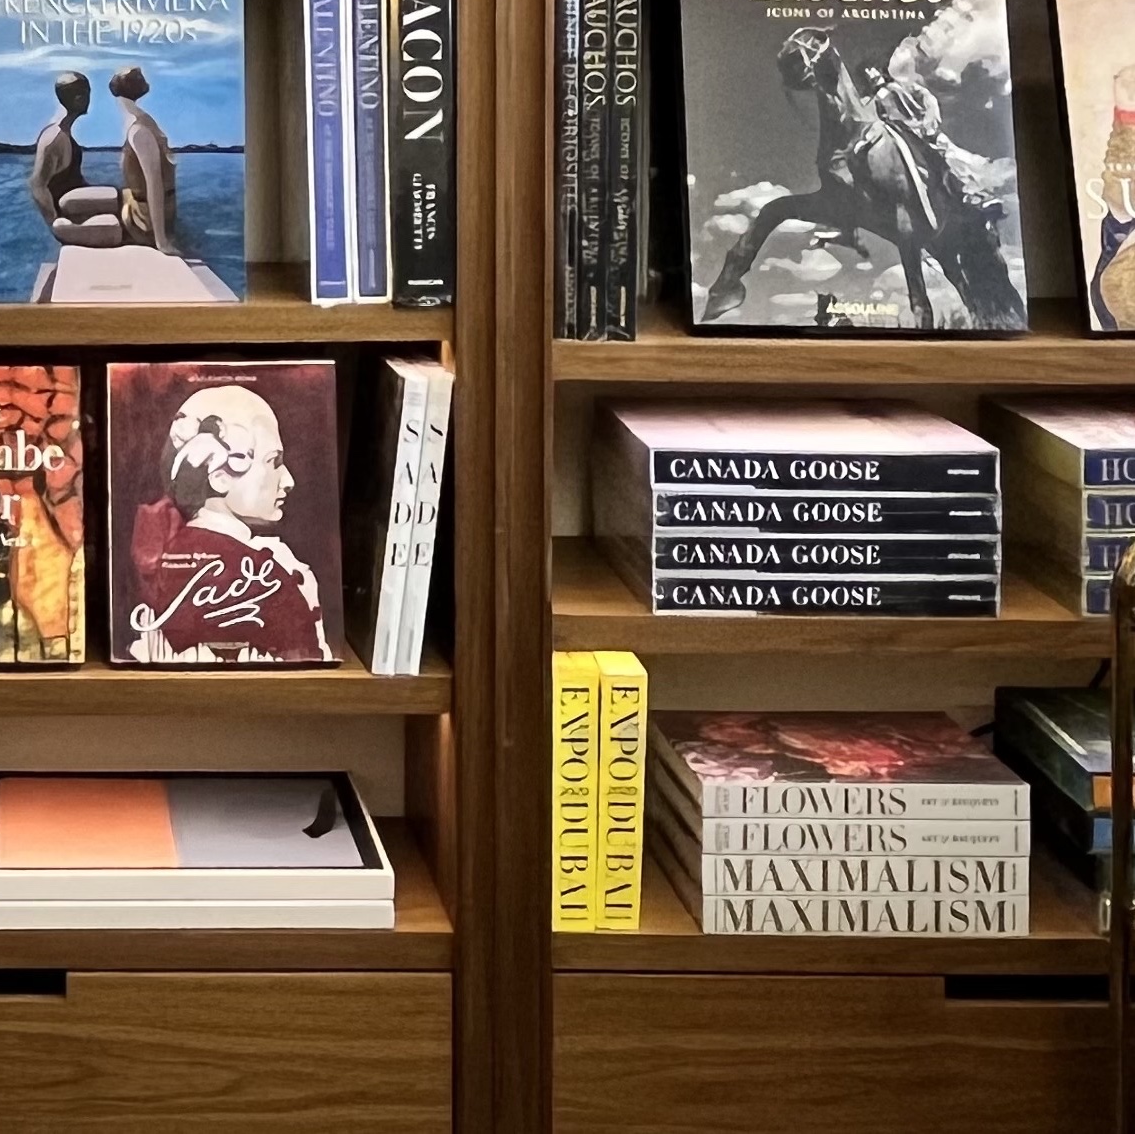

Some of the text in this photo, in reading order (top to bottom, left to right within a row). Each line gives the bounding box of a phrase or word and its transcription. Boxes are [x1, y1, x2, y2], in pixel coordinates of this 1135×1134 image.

[20, 19, 199, 45] IN THE 1920s
[669, 458, 881, 482] CANADA GOOSE
[673, 502, 883, 523] CANADA GOOSE
[672, 544, 882, 566] CANADA GOOSE
[130, 557, 281, 631] Sade
[672, 585, 882, 607] CANADA GOOSE
[561, 687, 591, 783] EXPO
[604, 686, 640, 910] EXPO DUBAI
[741, 787, 907, 815] FLOWERS
[742, 823, 907, 852] FLOWERS
[560, 802, 590, 912] DUBAI
[723, 859, 1006, 894] MAXIMALISM
[722, 898, 1006, 933] MAXIMALISM
